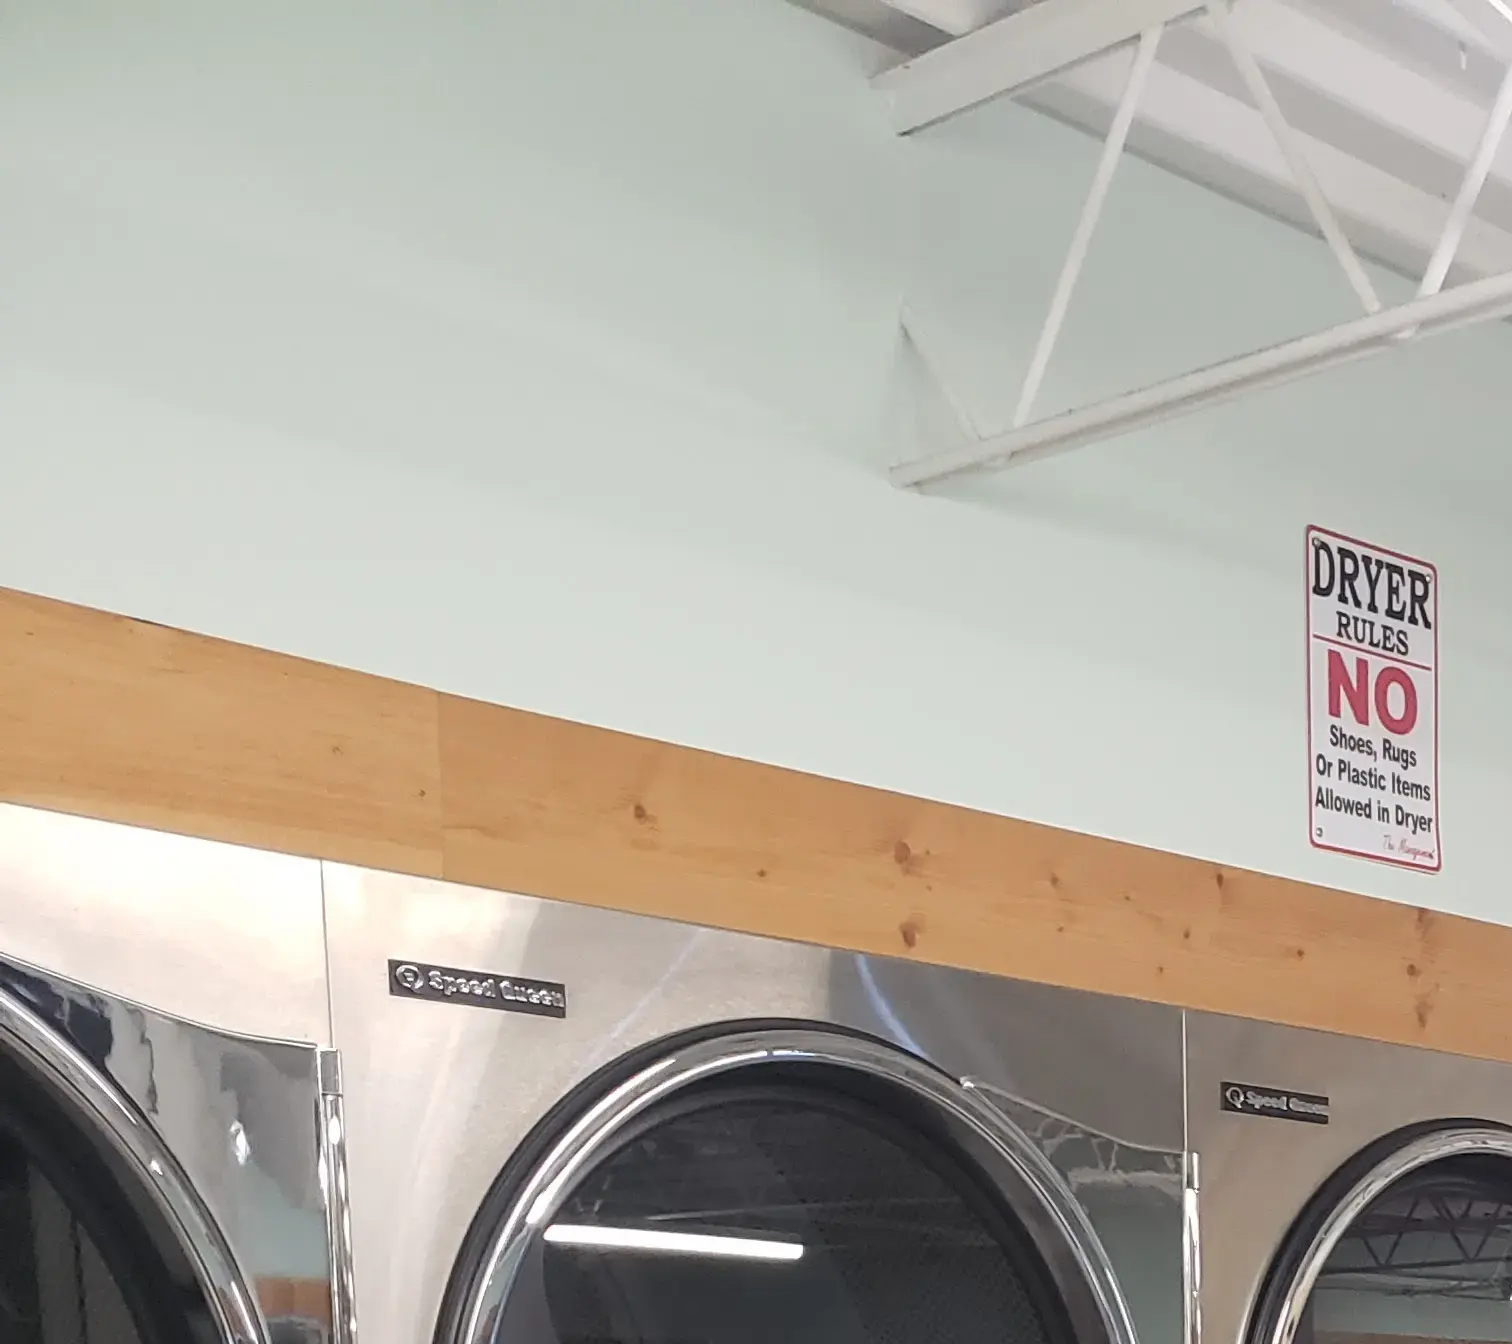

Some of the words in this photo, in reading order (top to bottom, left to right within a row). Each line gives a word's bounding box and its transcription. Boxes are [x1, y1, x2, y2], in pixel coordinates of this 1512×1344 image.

[1312, 538, 1432, 629] DRYER
[1336, 610, 1409, 656] RULES
[1327, 648, 1418, 735] NO
[1330, 724, 1377, 762] Shoes,
[1382, 738, 1417, 770] Rugs
[1316, 753, 1333, 778] Or
[1338, 758, 1386, 791] Plastic
[1392, 772, 1431, 801] Items
[1315, 786, 1372, 820] Allowed
[1377, 800, 1390, 824] in
[1395, 804, 1433, 835] Dryer
